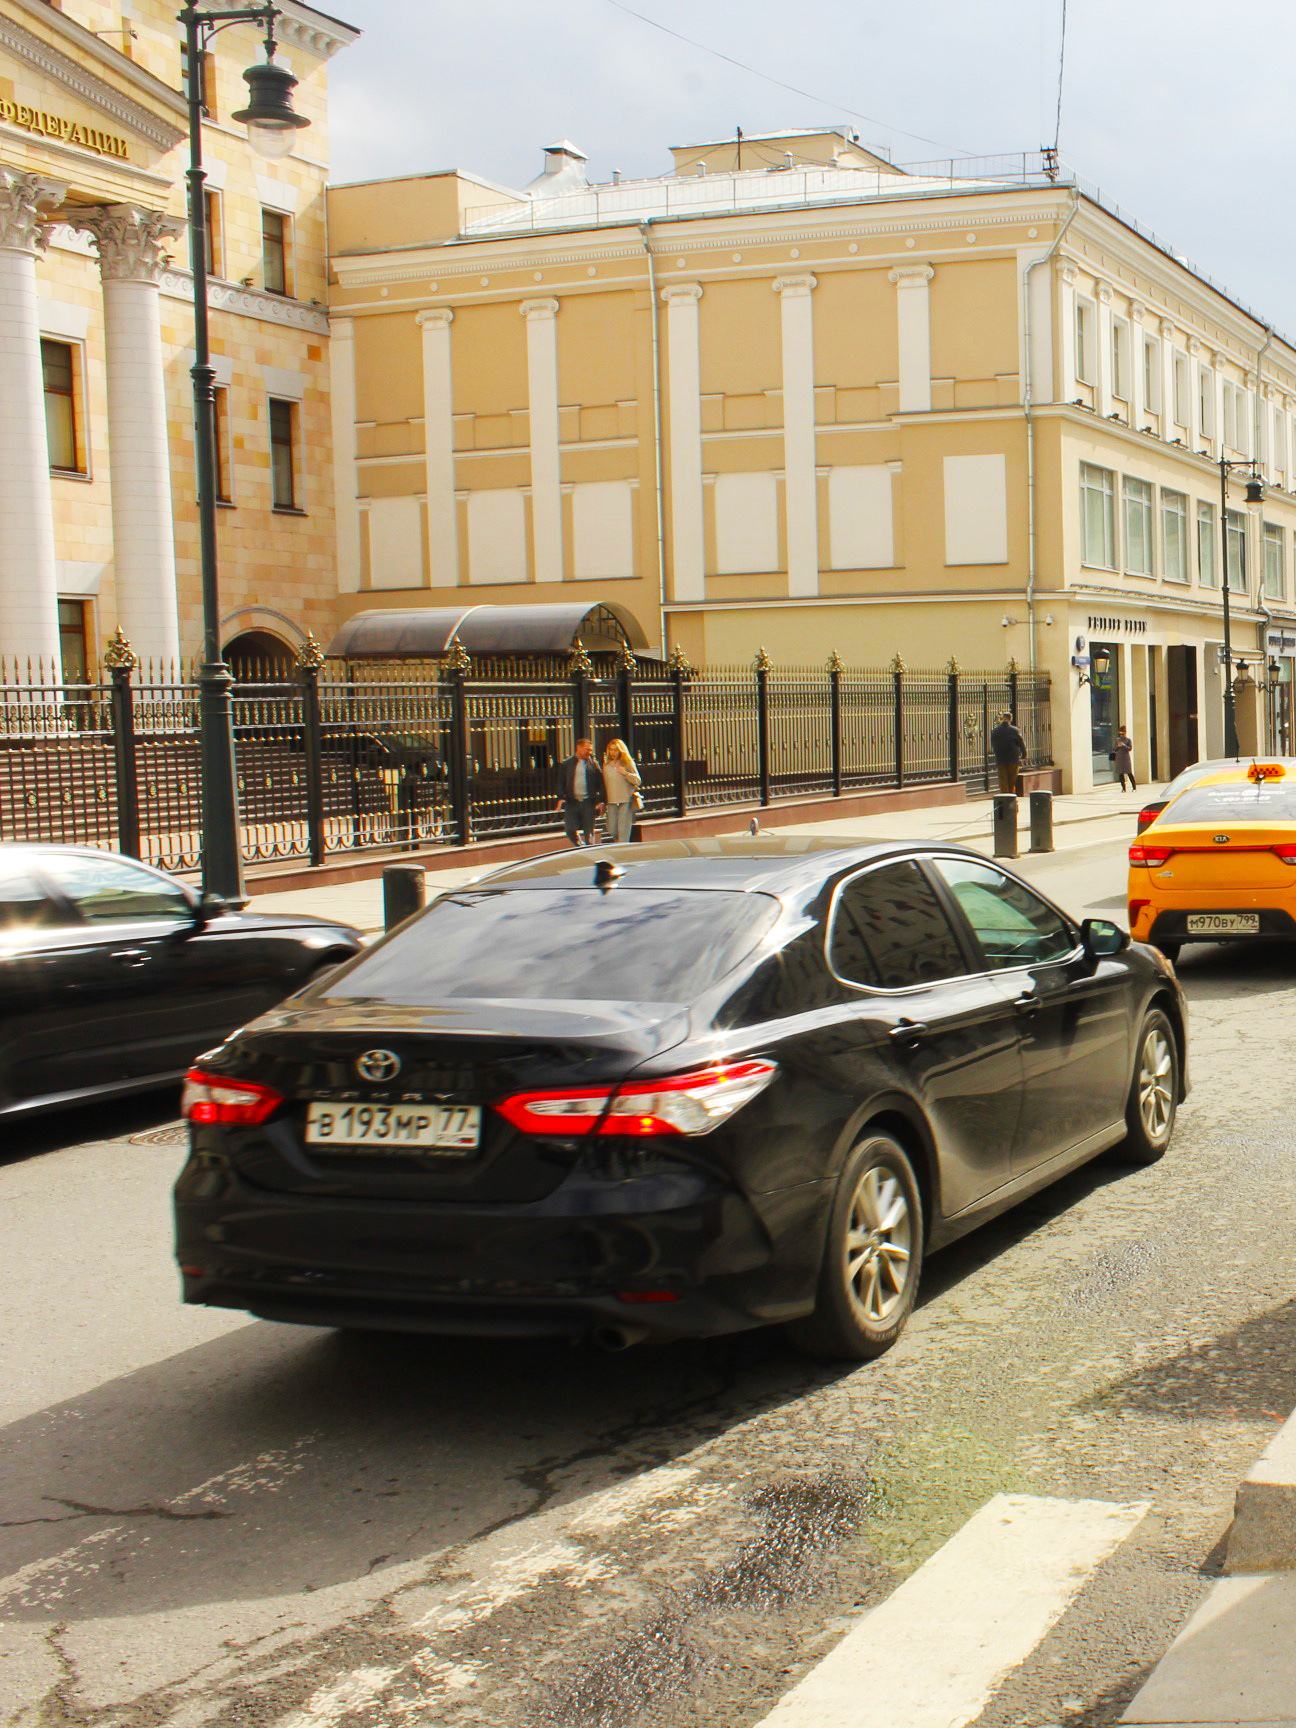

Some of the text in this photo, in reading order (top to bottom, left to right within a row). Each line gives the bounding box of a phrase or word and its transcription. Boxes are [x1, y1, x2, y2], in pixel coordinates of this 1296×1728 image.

[1088, 616, 1121, 630] PHILIPP
[1239, 914, 1256, 925] 799
[440, 1107, 470, 1133] 77
